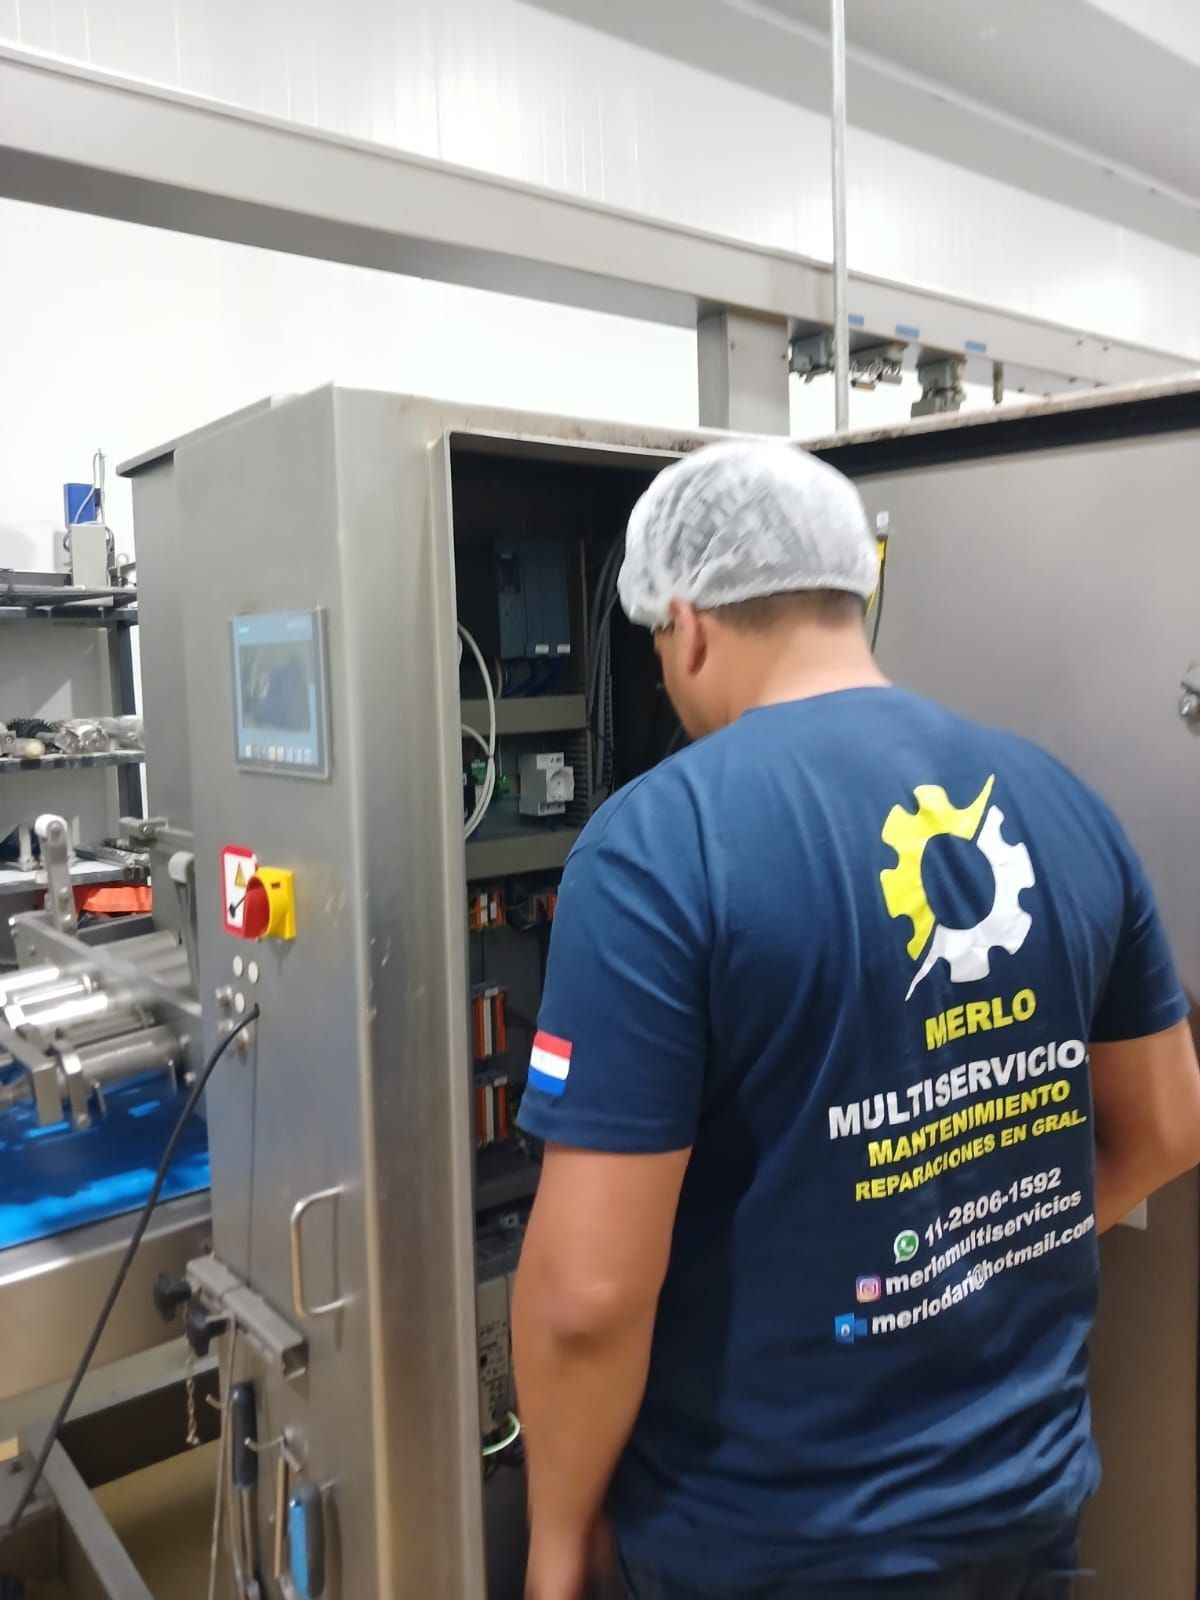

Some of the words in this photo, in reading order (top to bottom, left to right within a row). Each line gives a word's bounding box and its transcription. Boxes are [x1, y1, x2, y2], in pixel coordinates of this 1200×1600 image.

[925, 988, 1036, 1050] MERLO
[828, 1040, 1089, 1139] MULTISERVICIO
[868, 1080, 1070, 1167] MANTENIMIENTO
[855, 1133, 995, 1201] REPARACIONES
[1000, 1124, 1026, 1146] EN
[885, 1190, 1081, 1296] merlomultiservicios
[925, 1167, 1061, 1247] 11-2806-1592
[872, 1213, 1094, 1334] merlodari@hotmail.com
